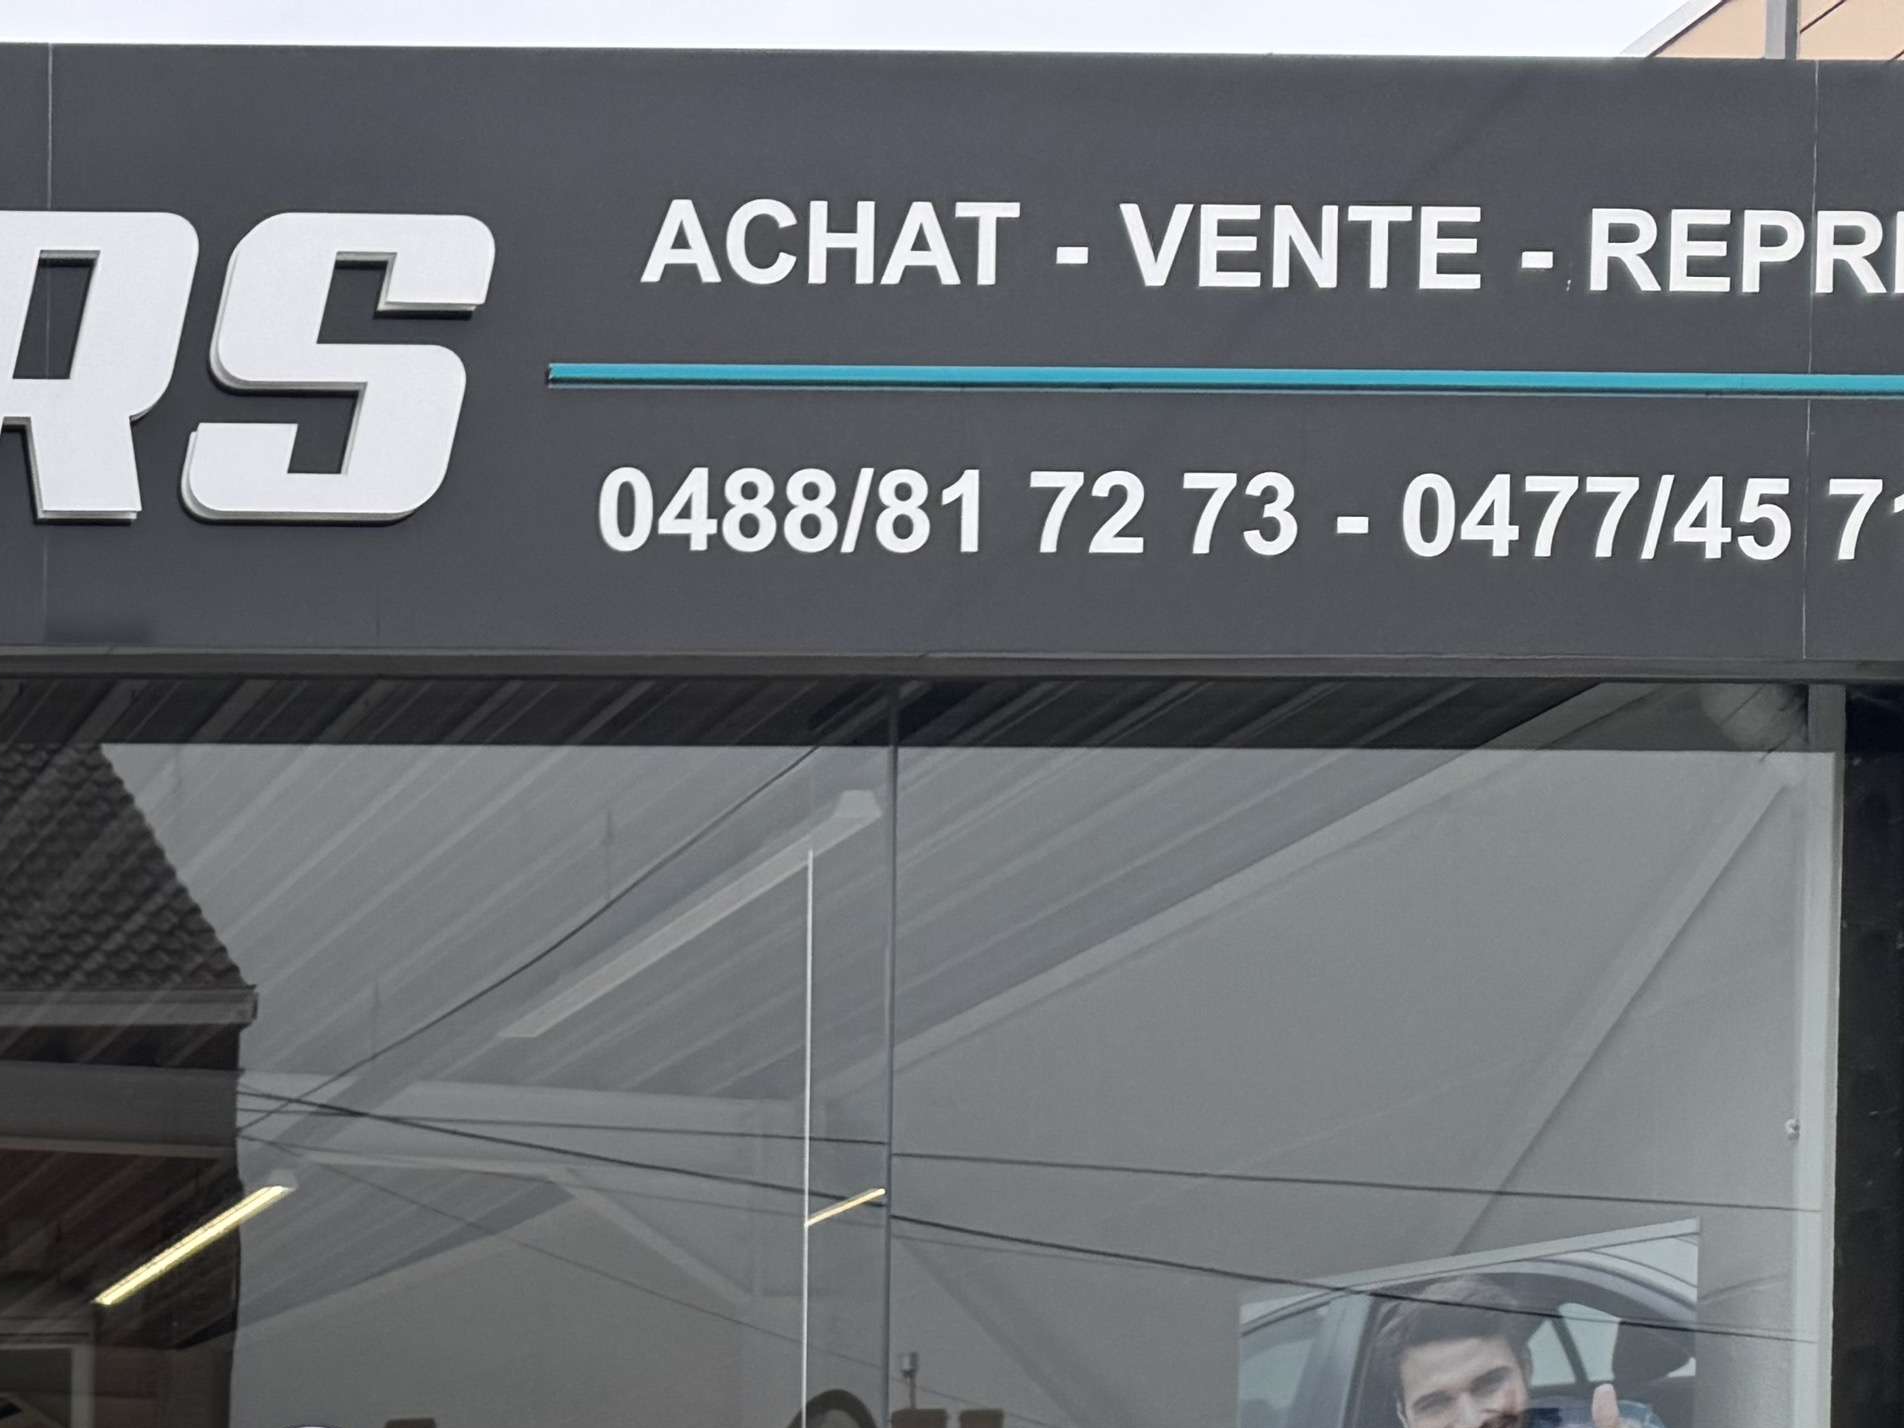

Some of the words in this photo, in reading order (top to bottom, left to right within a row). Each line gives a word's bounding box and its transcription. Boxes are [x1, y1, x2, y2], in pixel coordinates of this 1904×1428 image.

[640, 197, 1021, 286] ACHAT
[1119, 203, 1482, 291] VENTE
[598, 466, 980, 556] 0488/81
[1029, 470, 1145, 555] 72
[1182, 471, 1298, 556] 73
[1402, 473, 1792, 561] 0477/45
[1828, 478, 1904, 561] 7
